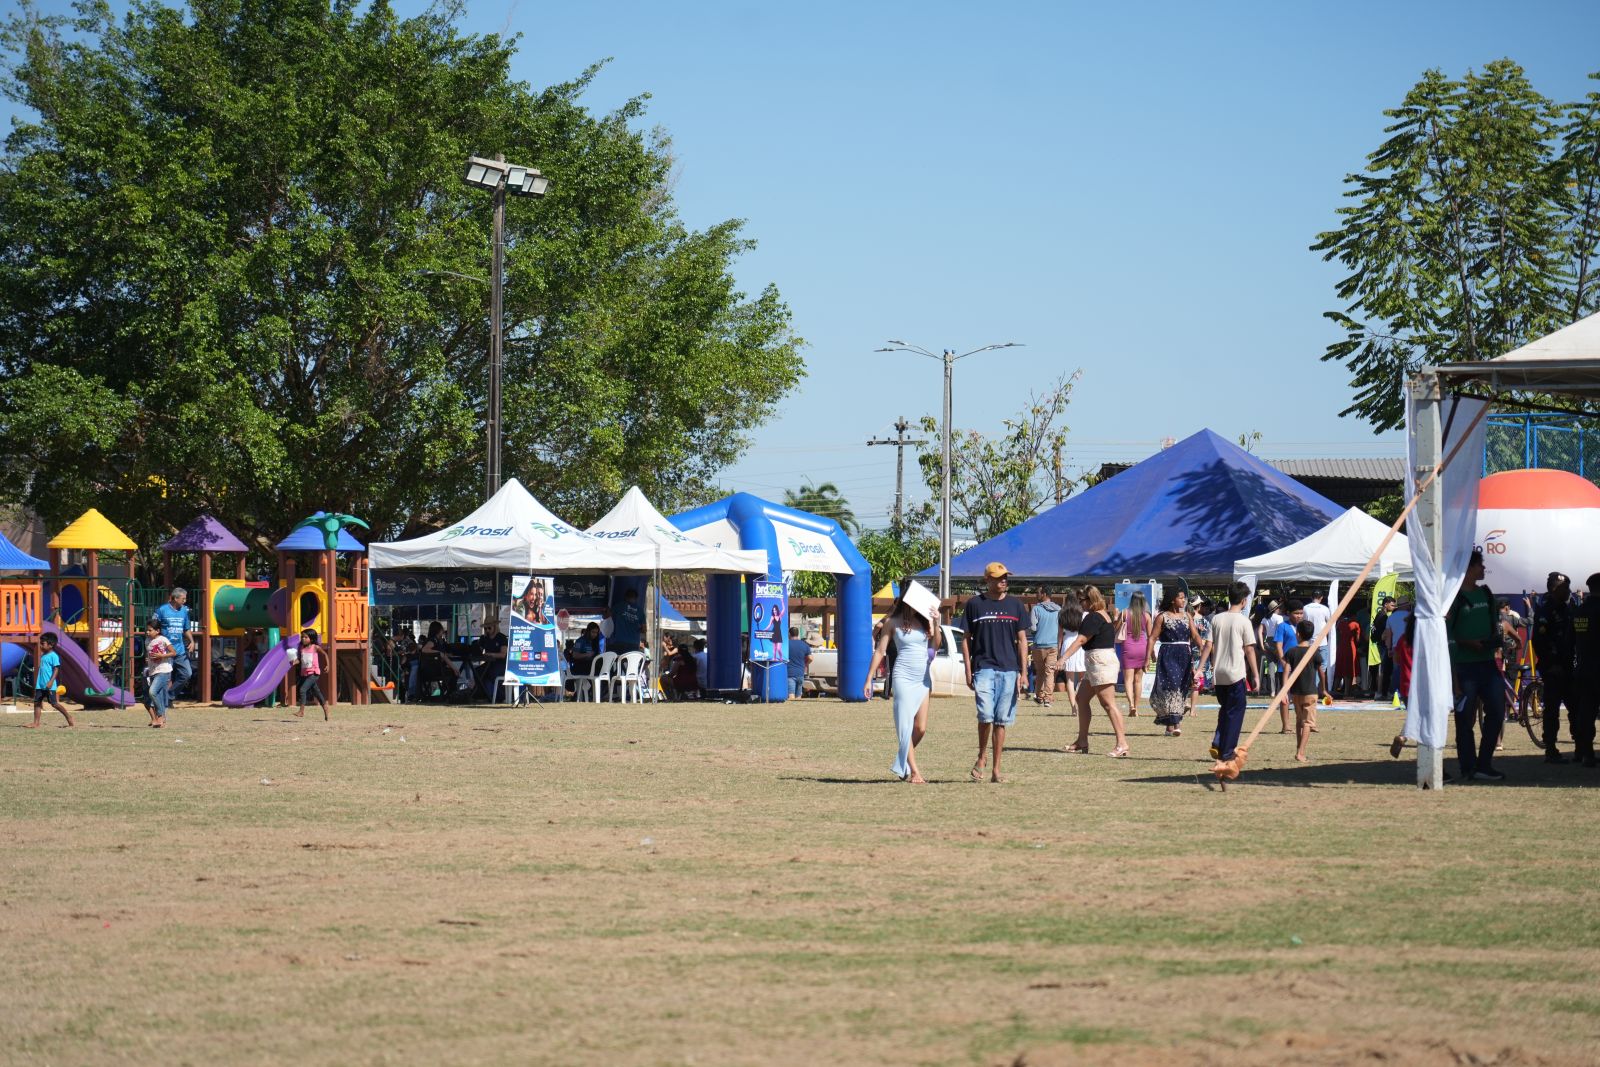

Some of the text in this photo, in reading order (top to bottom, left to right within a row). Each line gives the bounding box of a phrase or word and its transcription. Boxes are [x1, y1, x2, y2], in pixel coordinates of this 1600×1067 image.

[461, 525, 513, 536] Brasil
[799, 541, 826, 554] Brasil
[1486, 542, 1506, 555] RO
